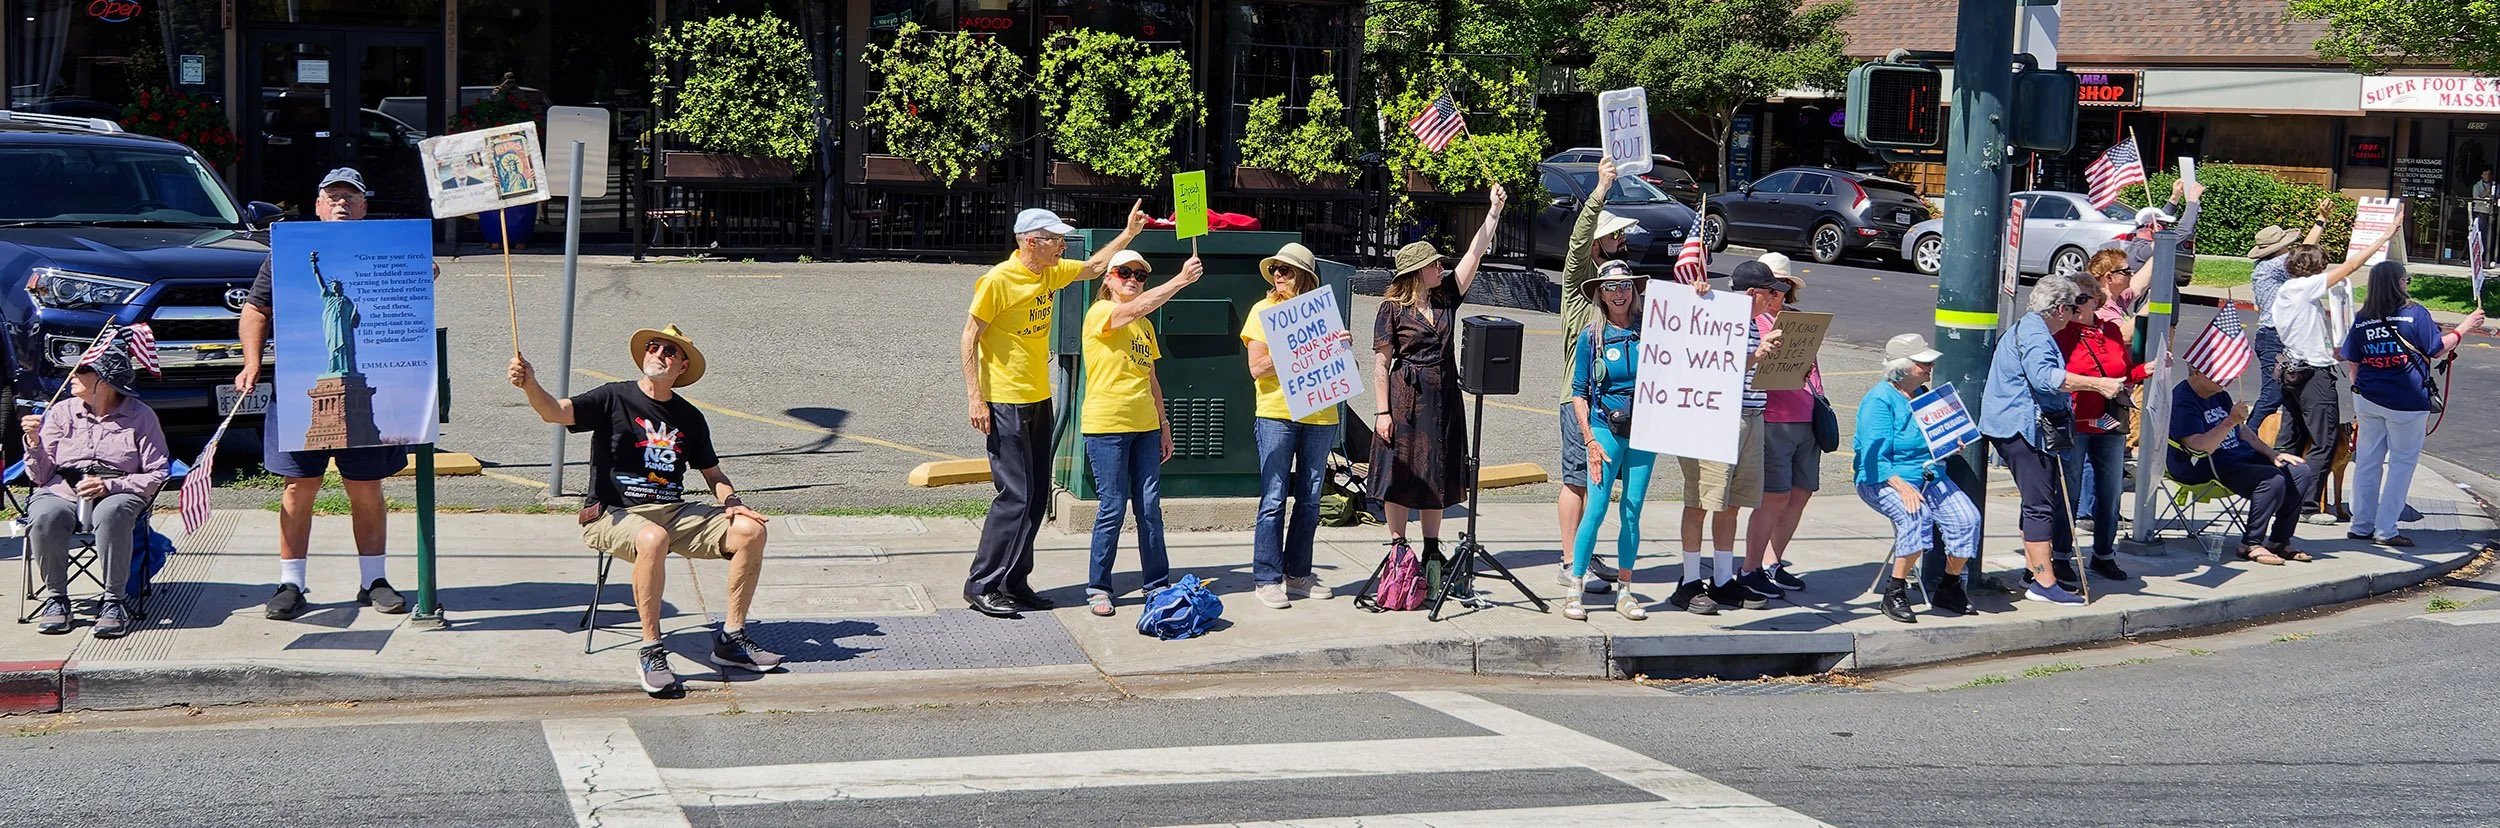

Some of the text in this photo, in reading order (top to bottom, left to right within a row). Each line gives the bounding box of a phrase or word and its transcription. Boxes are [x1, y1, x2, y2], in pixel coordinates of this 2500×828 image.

[88, 0, 143, 18] Open
[957, 16, 1014, 30] EAFOOD
[2078, 85, 2125, 101] SHOP
[2366, 79, 2416, 105] SUPER
[2423, 77, 2468, 92] FOOT
[2474, 78, 2487, 92] &
[2439, 93, 2500, 108] MASSA
[1608, 106, 1638, 132] ICE
[1612, 136, 1642, 161] OUT
[349, 279, 380, 287] yearning
[380, 294, 409, 302] teeming
[1029, 306, 1051, 322] Kings
[1268, 305, 1298, 332] YOU
[1649, 299, 1681, 332] No
[387, 328, 406, 336] lamp
[1286, 318, 1328, 351] BOMB
[1778, 321, 1819, 334] NO KINGS
[375, 335, 399, 344] golden
[1789, 337, 1815, 348] WAR
[1292, 338, 1320, 360] YOUR
[1764, 349, 1805, 360] NO ICE
[389, 360, 428, 368] LAZARUS
[1291, 354, 1315, 374] OUT
[1319, 344, 1333, 361] OF
[1642, 344, 1738, 373] No WAR
[1758, 362, 1805, 375] NO TRUMP
[1287, 358, 1345, 396] EPSTEIN
[1306, 378, 1351, 408] FILES
[1638, 381, 1722, 411] No ICE
[643, 447, 677, 464] NO
[644, 461, 676, 473] KINGS
